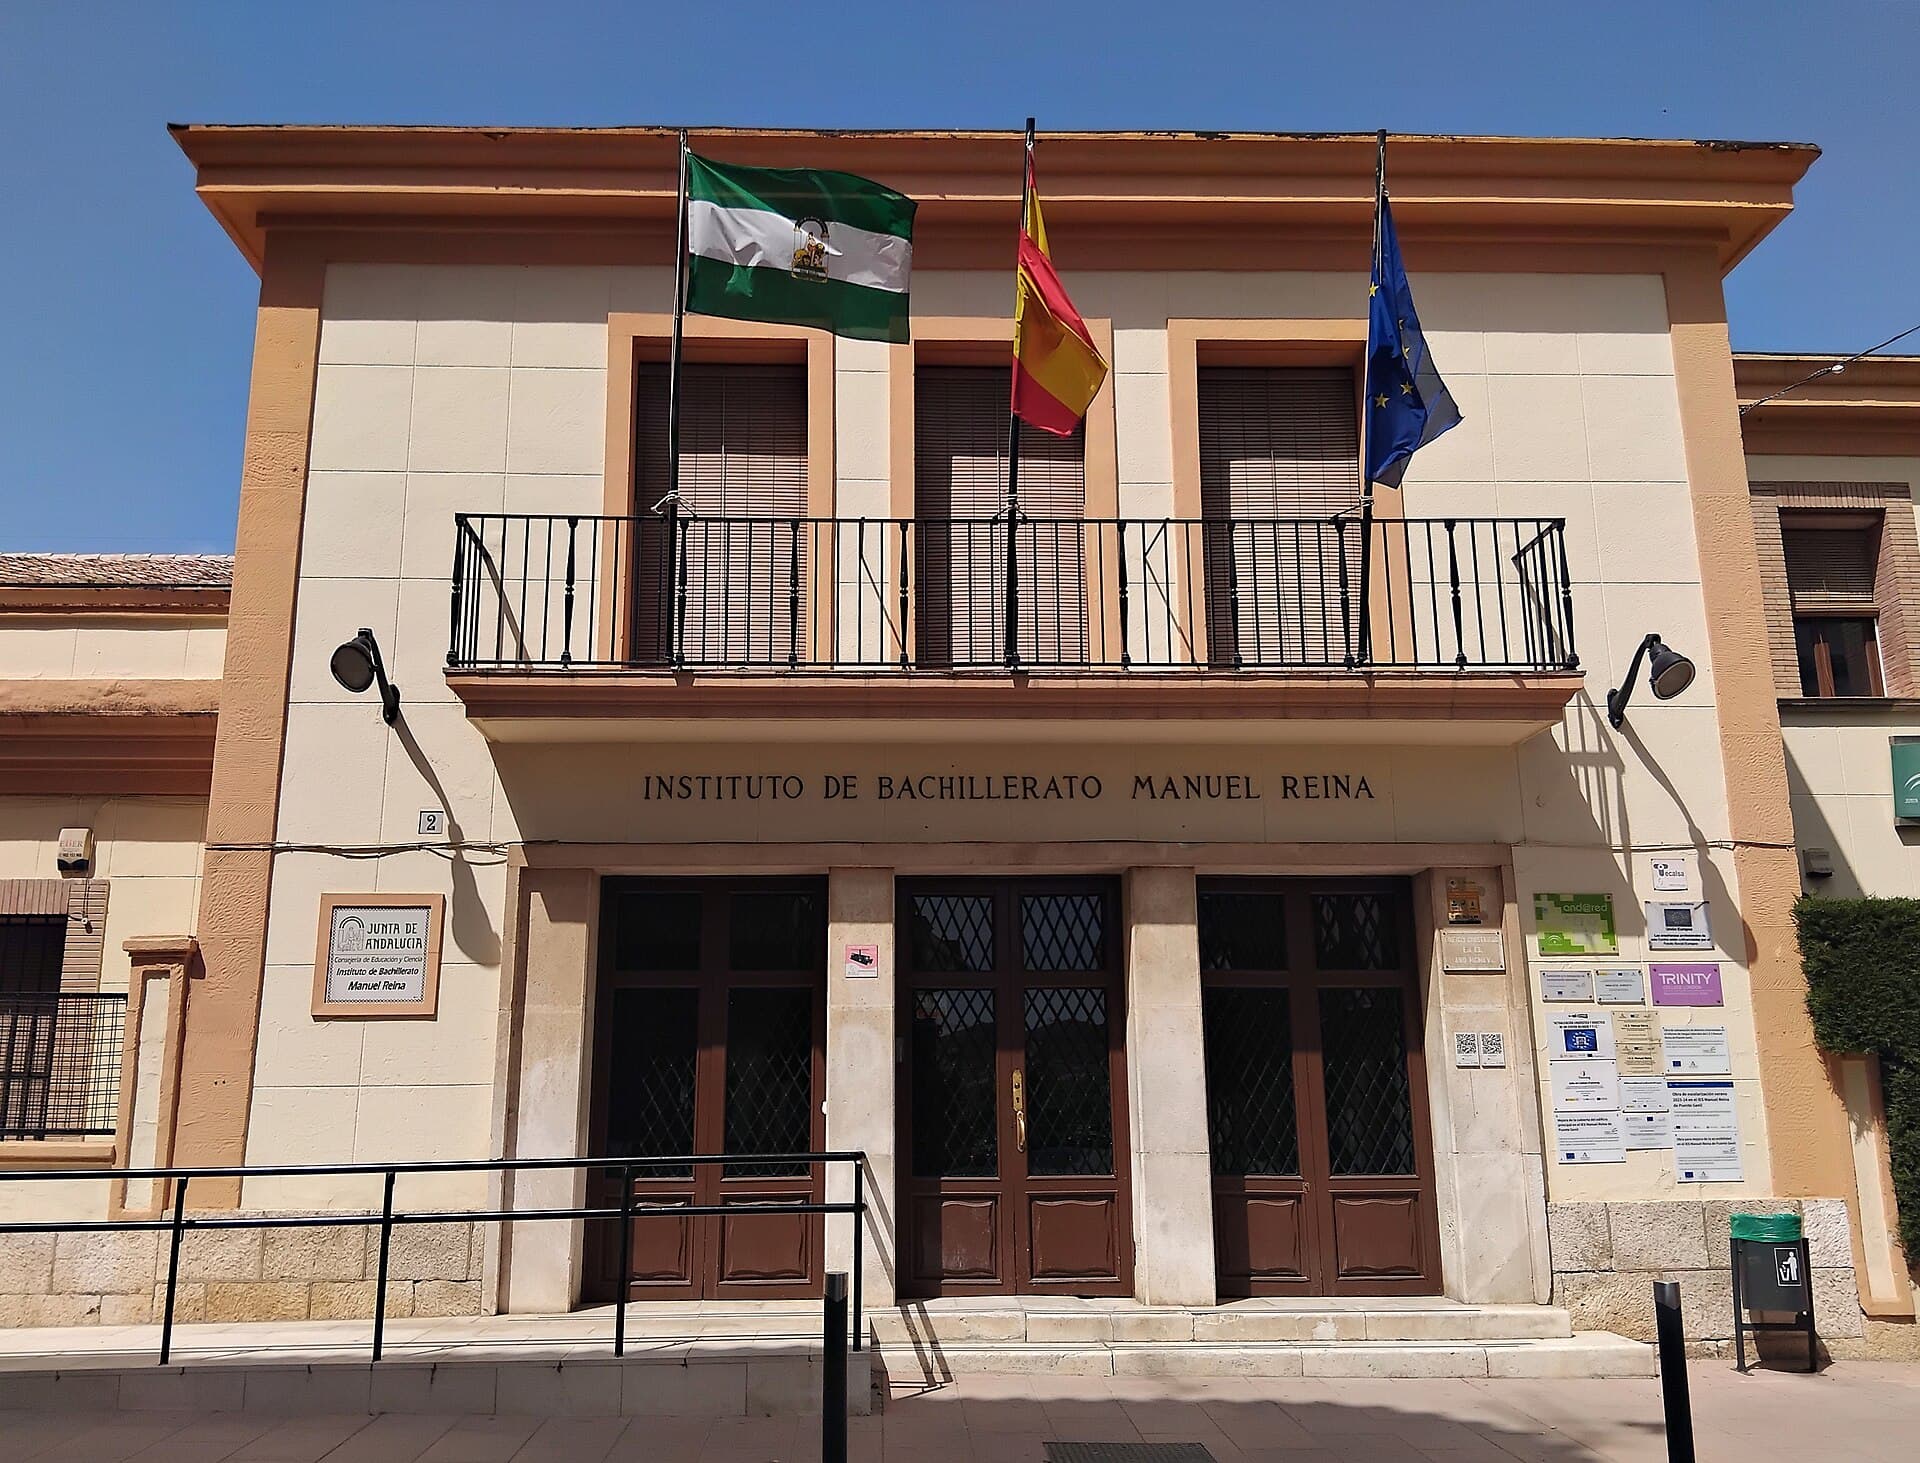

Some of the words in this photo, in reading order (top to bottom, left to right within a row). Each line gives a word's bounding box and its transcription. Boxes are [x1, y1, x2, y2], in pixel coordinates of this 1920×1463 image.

[643, 775, 804, 800] INSTITUTO
[823, 775, 858, 800] DE
[878, 775, 1101, 800] BACHILLERATO
[1131, 775, 1261, 800] MANUEL
[1281, 775, 1375, 800] REINA
[426, 814, 437, 831] 2
[367, 923, 400, 934] JUNTA
[405, 923, 418, 934] DE
[336, 967, 367, 976] Instituto
[368, 967, 378, 976] de
[379, 967, 419, 976] Bachillerato
[1658, 973, 1712, 985] TRINITY
[348, 981, 382, 991] Manuel
[382, 981, 406, 991] Reina
